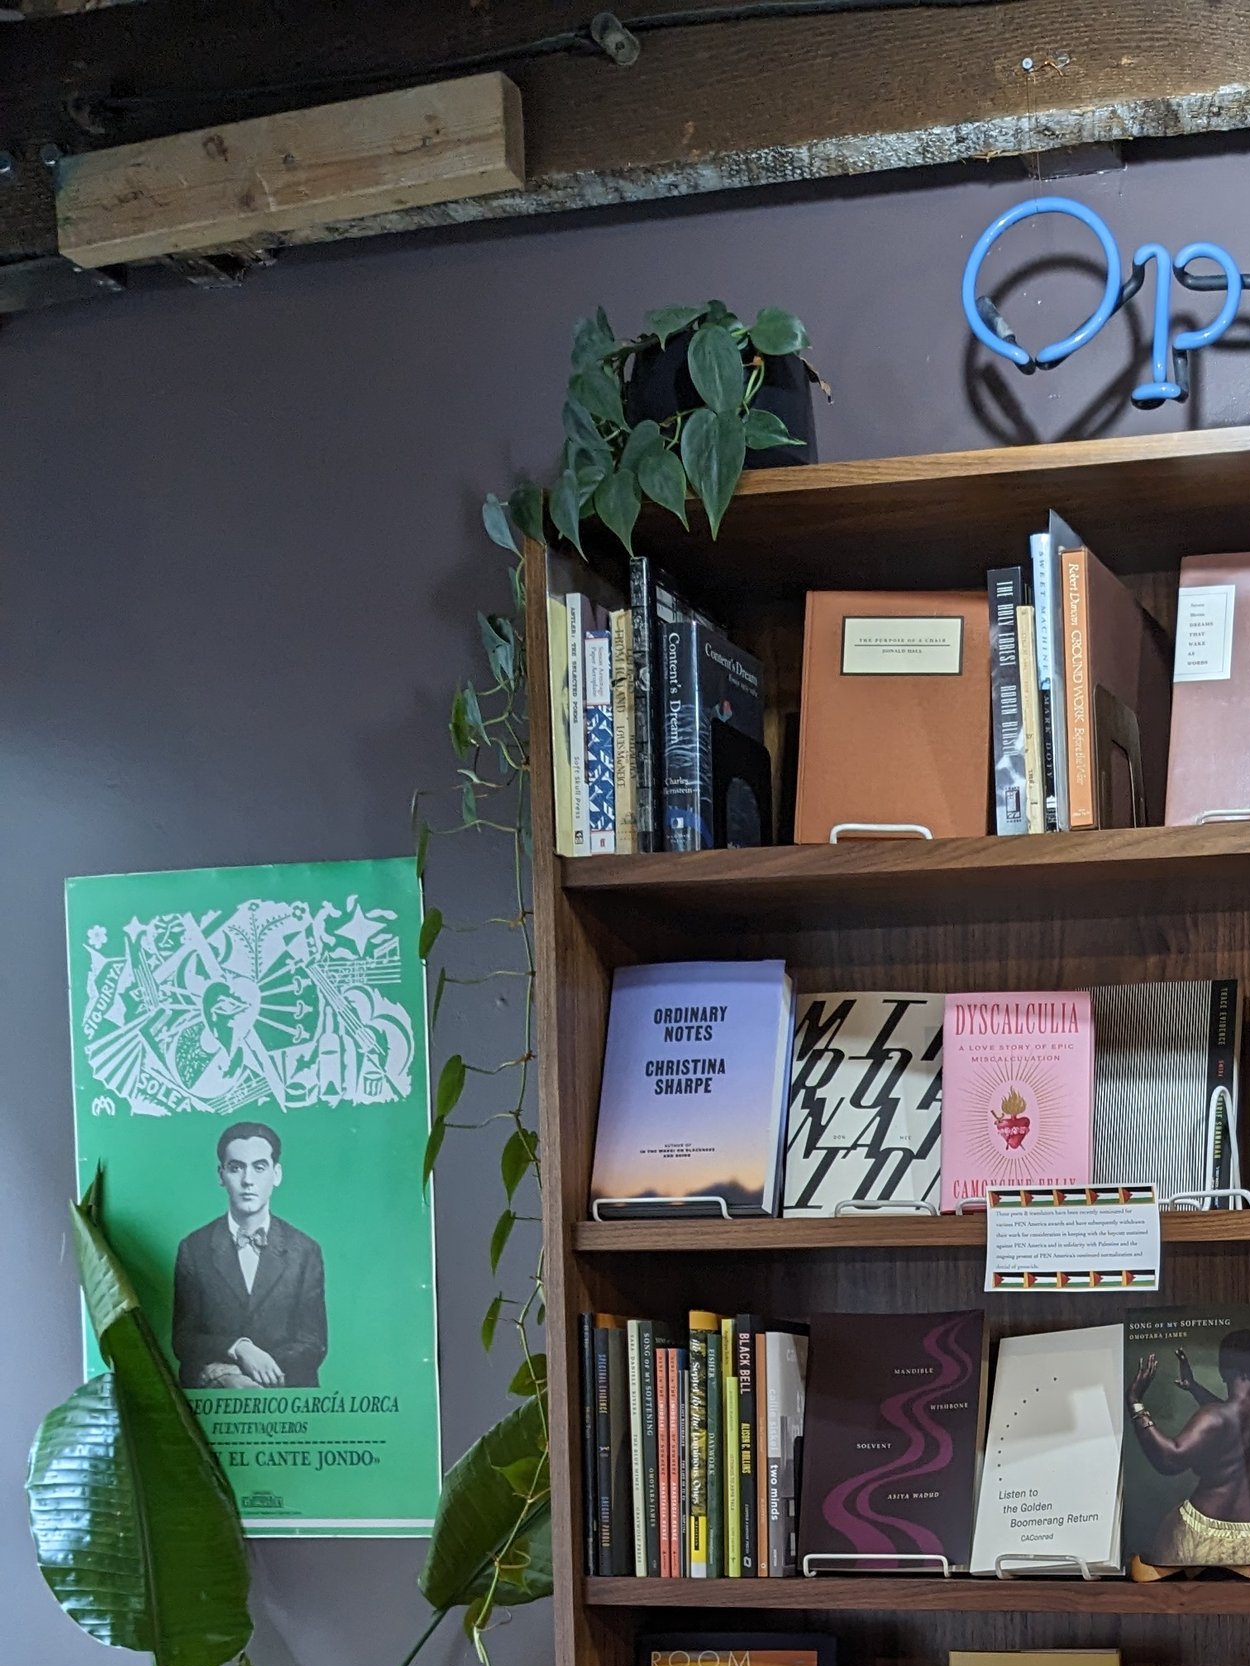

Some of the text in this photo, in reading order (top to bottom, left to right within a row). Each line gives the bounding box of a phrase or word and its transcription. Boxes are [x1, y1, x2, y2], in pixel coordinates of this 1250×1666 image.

[654, 1006, 728, 1024] ORDINARY
[955, 1003, 1079, 1036] DYSCALCULIA
[664, 1025, 713, 1042] NOTES
[972, 1055, 1061, 1063] MISCALCULATION
[645, 1059, 726, 1077] CHRISTINA
[655, 1078, 712, 1096] SHARPE
[1130, 1322, 1152, 1330] SONG
[1180, 1318, 1230, 1327] SOFTENING
[739, 1333, 750, 1394] BLACK BELL
[215, 1392, 399, 1414] FEDERICO GARCÍA LORCA
[229, 1451, 249, 1466] EL
[256, 1451, 311, 1466] CANTE
[999, 1488, 1038, 1501] Listen to
[1003, 1501, 1052, 1514] the Golden
[1010, 1511, 1099, 1529] Boomerang Return
[1021, 1533, 1053, 1542] CAConrad
